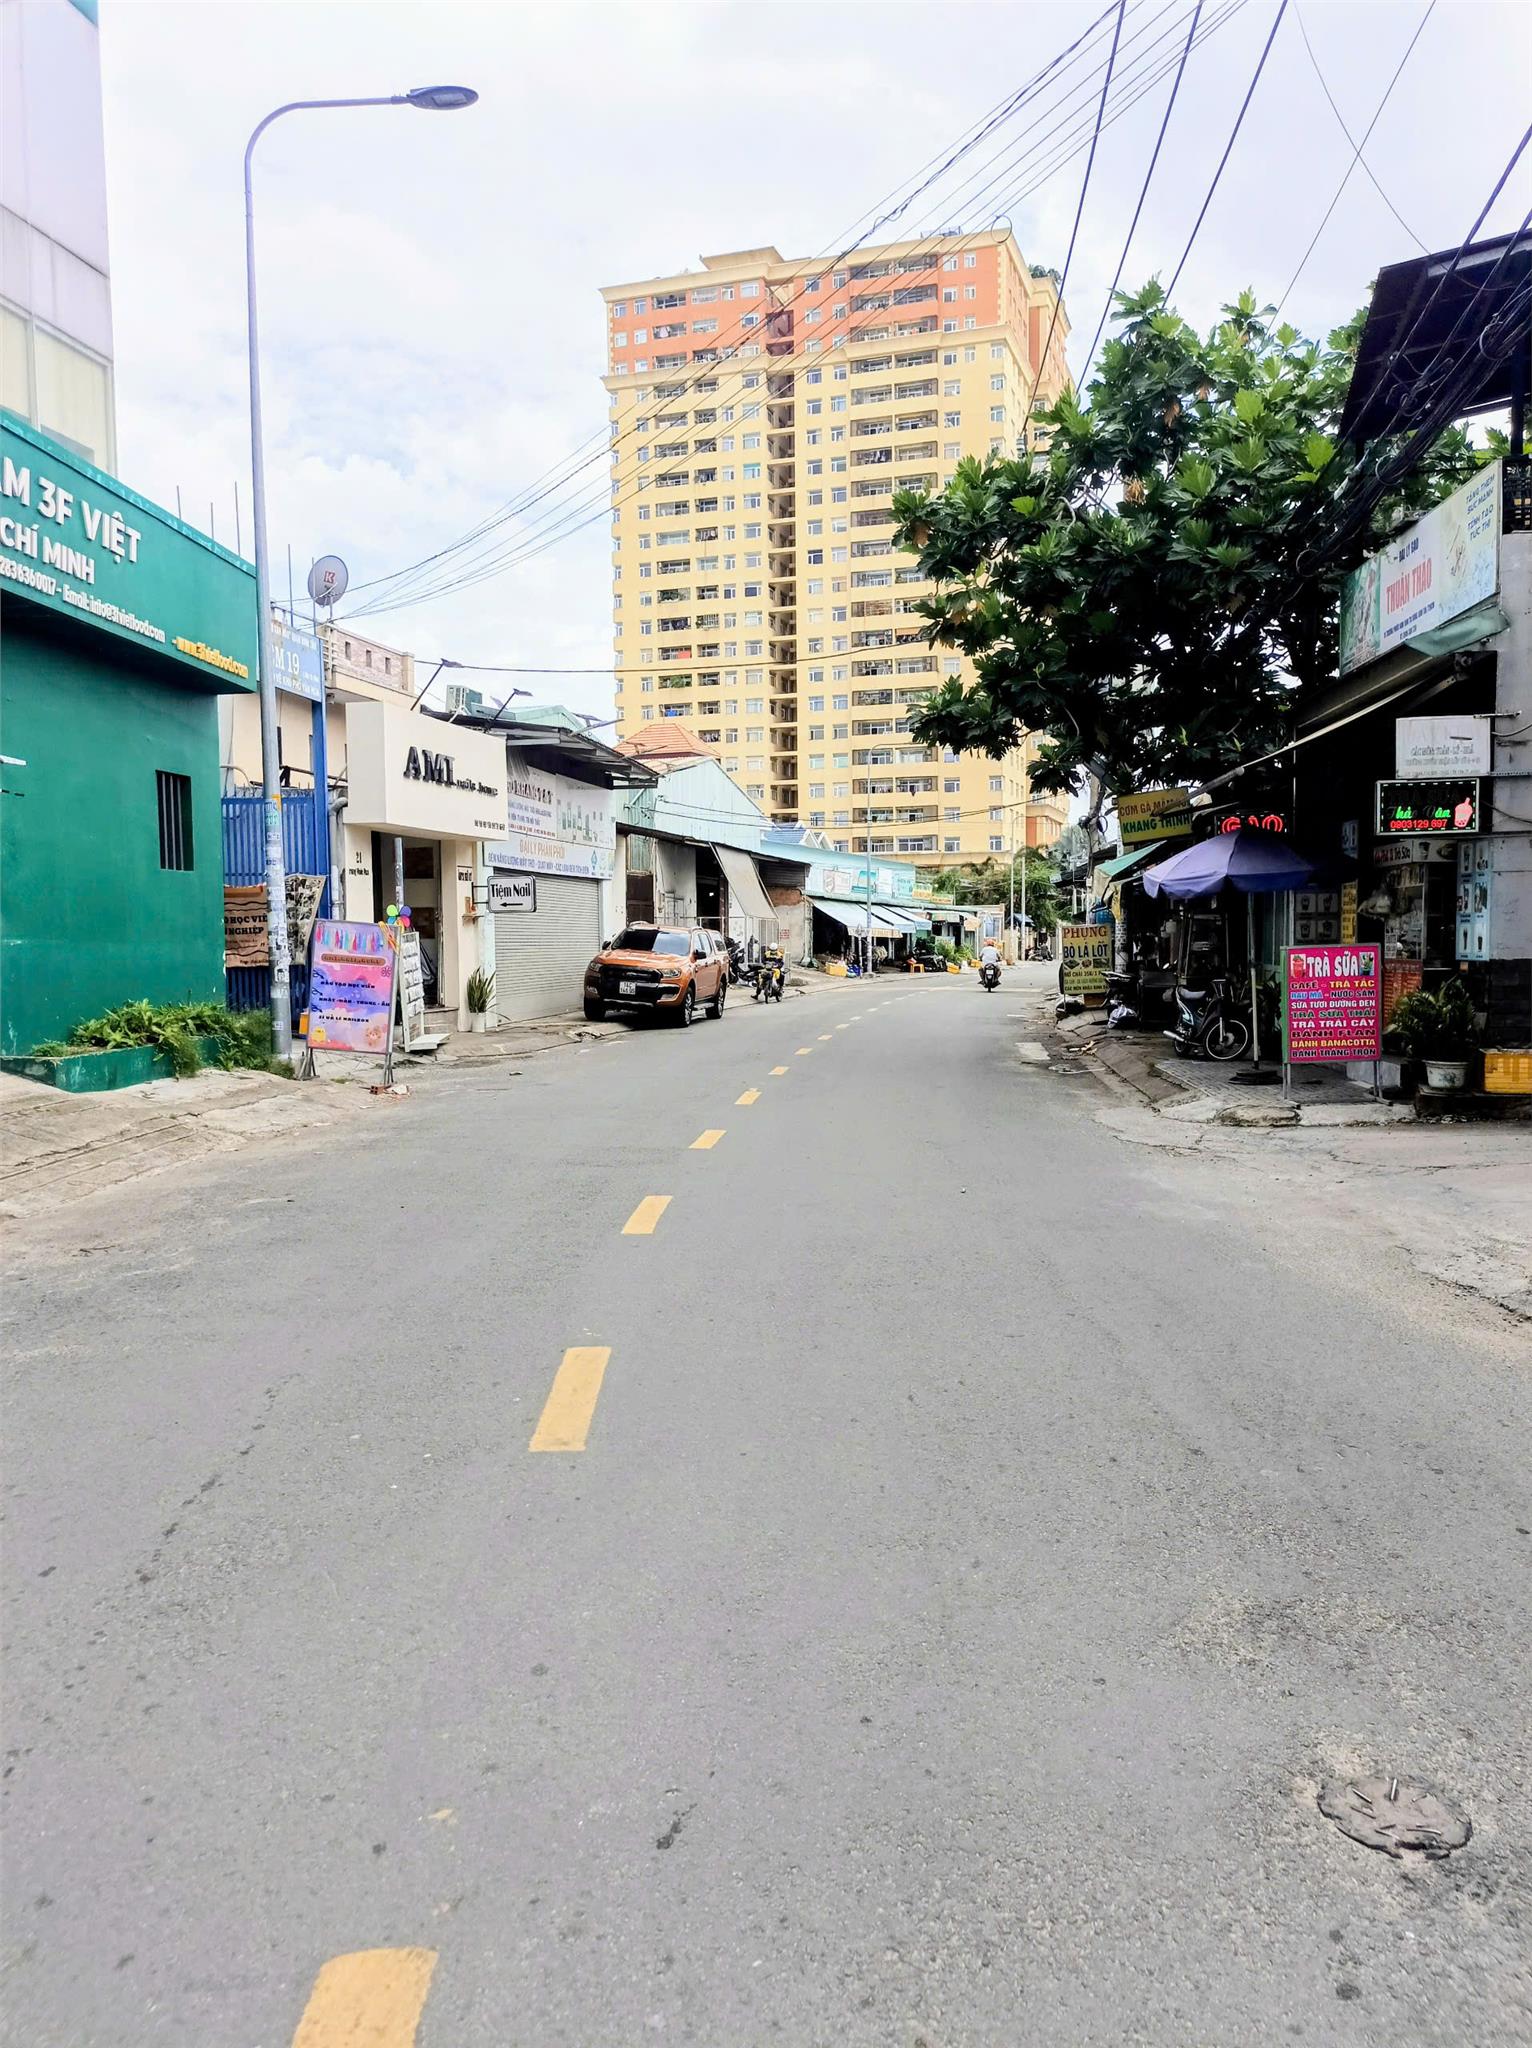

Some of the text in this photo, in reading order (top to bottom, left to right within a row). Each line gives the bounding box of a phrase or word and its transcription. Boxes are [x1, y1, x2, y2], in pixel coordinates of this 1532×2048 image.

[0, 456, 142, 564] M 3F VIỆT
[0, 516, 95, 585] CHÍ MINH
[271, 644, 300, 675] M 19
[1122, 813, 1190, 834] KHANG THỊNH
[490, 883, 532, 900] Tiệm Nail
[230, 915, 249, 925] HỌC
[229, 925, 265, 936] NGHIỆP
[1063, 926, 1107, 941] PHỤNG
[1063, 942, 1076, 958] BÒ
[1078, 941, 1089, 958] LÁ
[1307, 951, 1359, 978] TRÀ SỮA
[1330, 980, 1350, 988] TRÀ
[1291, 992, 1308, 1000] RAU
[1309, 990, 1324, 1000] MÁ
[1330, 990, 1354, 999] NƯỚC
[1291, 1001, 1308, 1009] SỮA
[1309, 1000, 1328, 1009] TƯƠI
[1329, 999, 1357, 1008] ĐƯỜNG
[1292, 1009, 1375, 1019] TRÀ SỮA THÁI
[1292, 1018, 1375, 1028] TRÀ TRÁI CÂY
[1292, 1028, 1375, 1038] BÁNH FLAN
[1292, 1039, 1375, 1048] BÁNH BANACOTTA
[1292, 1049, 1317, 1057] BÁNH
[1320, 1048, 1349, 1057] TRÁNG
